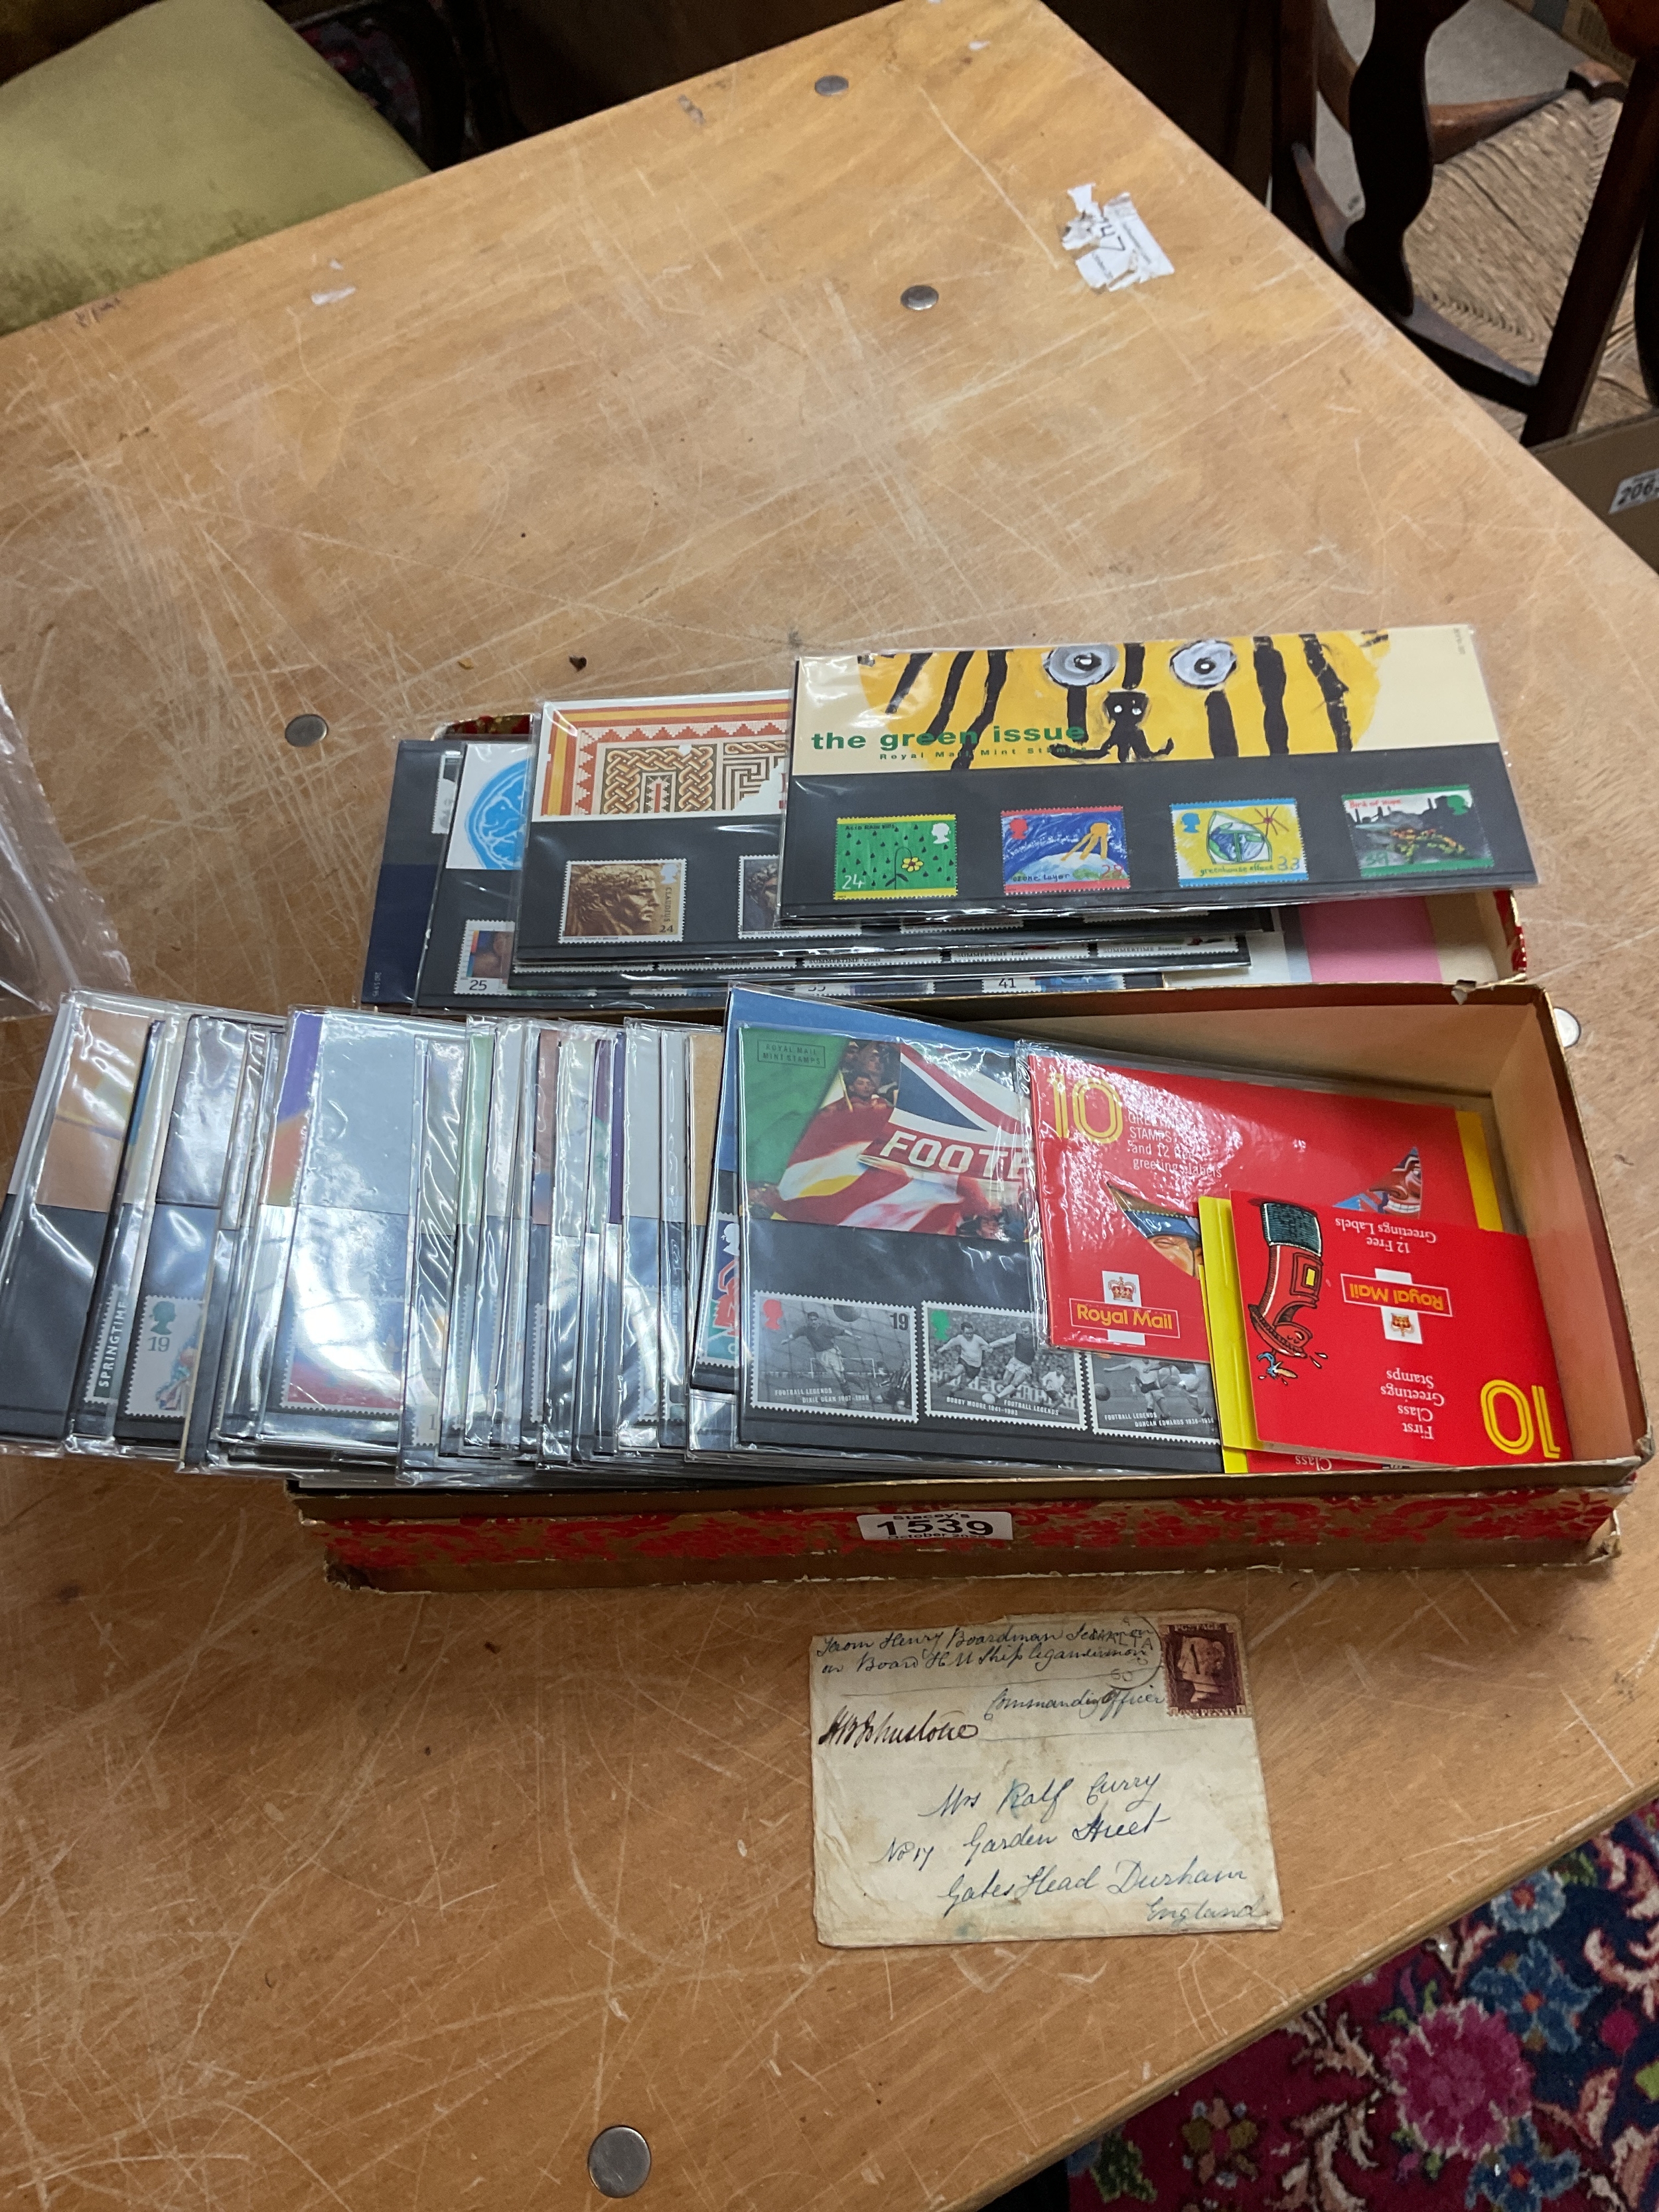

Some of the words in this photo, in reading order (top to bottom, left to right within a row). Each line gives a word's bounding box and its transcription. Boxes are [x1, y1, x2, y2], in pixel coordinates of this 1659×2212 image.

[811, 732, 866, 749] the
[880, 730, 978, 751] green
[993, 725, 1085, 743] issue
[880, 752, 924, 761] Royal
[936, 750, 972, 759] Mail
[981, 748, 1016, 757] Mint
[1277, 855, 1301, 871] 33
[1101, 864, 1125, 880] 28
[842, 875, 863, 890] 24
[660, 924, 674, 933] 24
[469, 979, 487, 991] 25
[999, 978, 1017, 989] 41
[766, 1044, 792, 1053] ROYAL
[797, 1047, 816, 1055] MAIL
[786, 1055, 820, 1065] STAMPS
[1046, 1072, 1123, 1143] 10
[1129, 1126, 1173, 1142] STAMPS
[1132, 1143, 1152, 1155] and
[1335, 1217, 1376, 1234] Labels
[1378, 1222, 1437, 1244] Greetings
[1366, 1236, 1394, 1252] Free
[1397, 1242, 1410, 1254] 12
[1349, 1283, 1388, 1302] Mail
[1393, 1288, 1444, 1311] Royal
[890, 1312, 909, 1331] 19
[1077, 1303, 1128, 1326] Royal
[1133, 1311, 1173, 1330] Mail
[98, 1300, 127, 1388] SPRINGTIME
[147, 1335, 170, 1353] 19
[1386, 1368, 1434, 1389] Stamps
[1380, 1382, 1445, 1407] Greetings
[1003, 1399, 1032, 1411] FOOTBALL
[1033, 1405, 1059, 1416] LEGENDS
[1398, 1405, 1433, 1422] Class
[1480, 1379, 1561, 1459] 10
[1402, 1423, 1435, 1440] First
[1295, 1455, 1333, 1471] Class
[877, 1518, 994, 1536] 1539
[879, 1631, 944, 1659] Henry
[918, 1783, 981, 1817] Mrs
[964, 1822, 1057, 1866] Garden
[1072, 1802, 1171, 1843] Street
[1107, 1855, 1248, 1895] Durham
[1146, 1894, 1267, 1923] England
